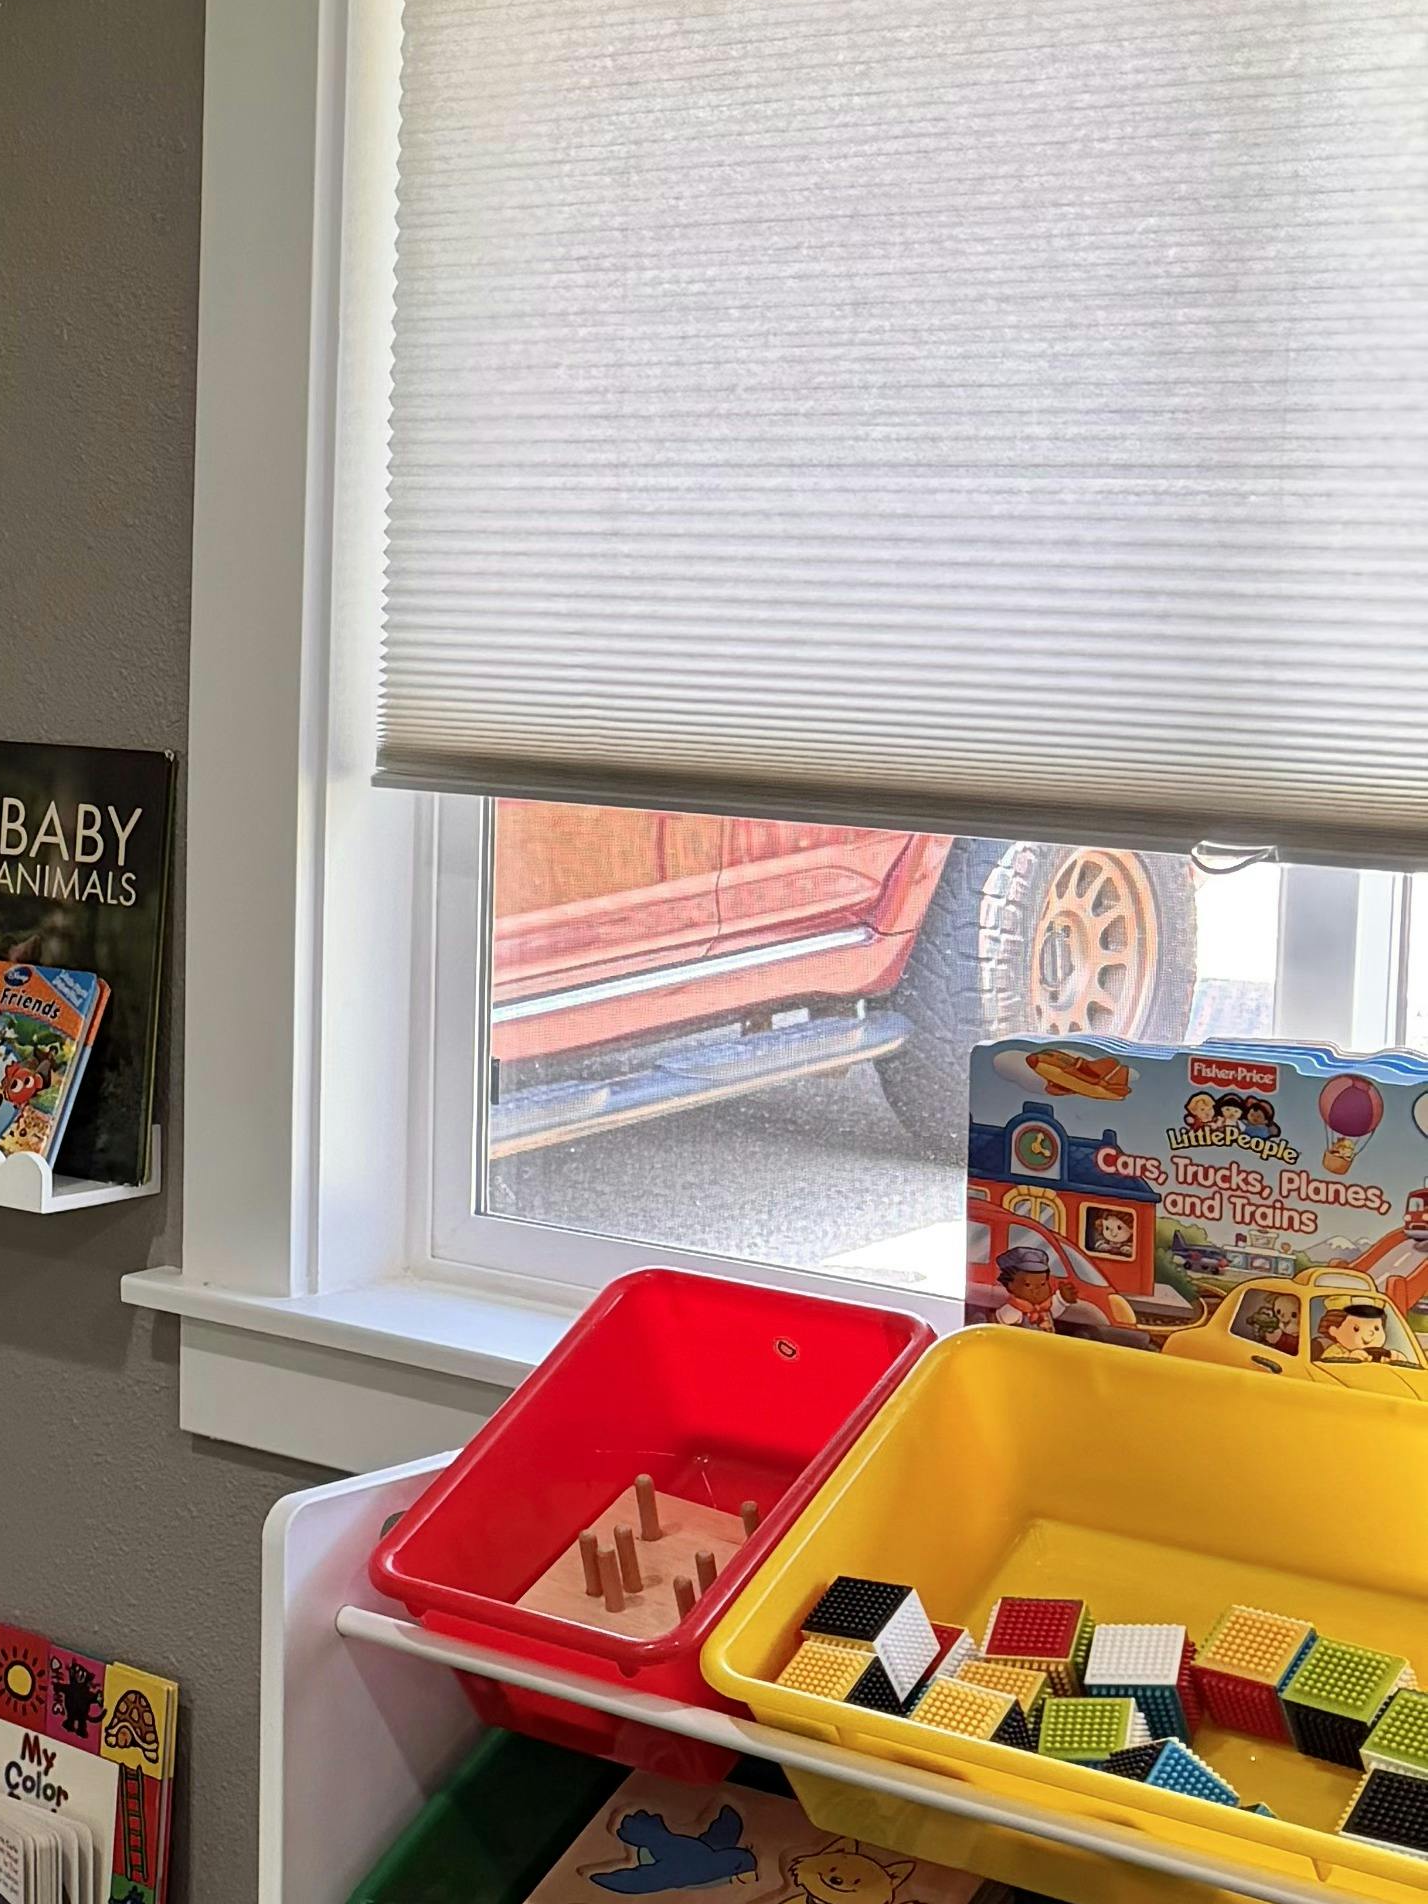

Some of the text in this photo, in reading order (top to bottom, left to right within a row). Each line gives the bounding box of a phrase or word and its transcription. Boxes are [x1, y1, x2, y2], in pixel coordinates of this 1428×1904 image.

[0, 797, 142, 866] BABY
[0, 987, 61, 1019] Friends
[1167, 1125, 1301, 1164] Little People
[1096, 1147, 1392, 1214] Cars, Trucks, Planes,
[1164, 1192, 1318, 1234] and Trains
[20, 1732, 57, 1776] My
[5, 1760, 69, 1808] Color
